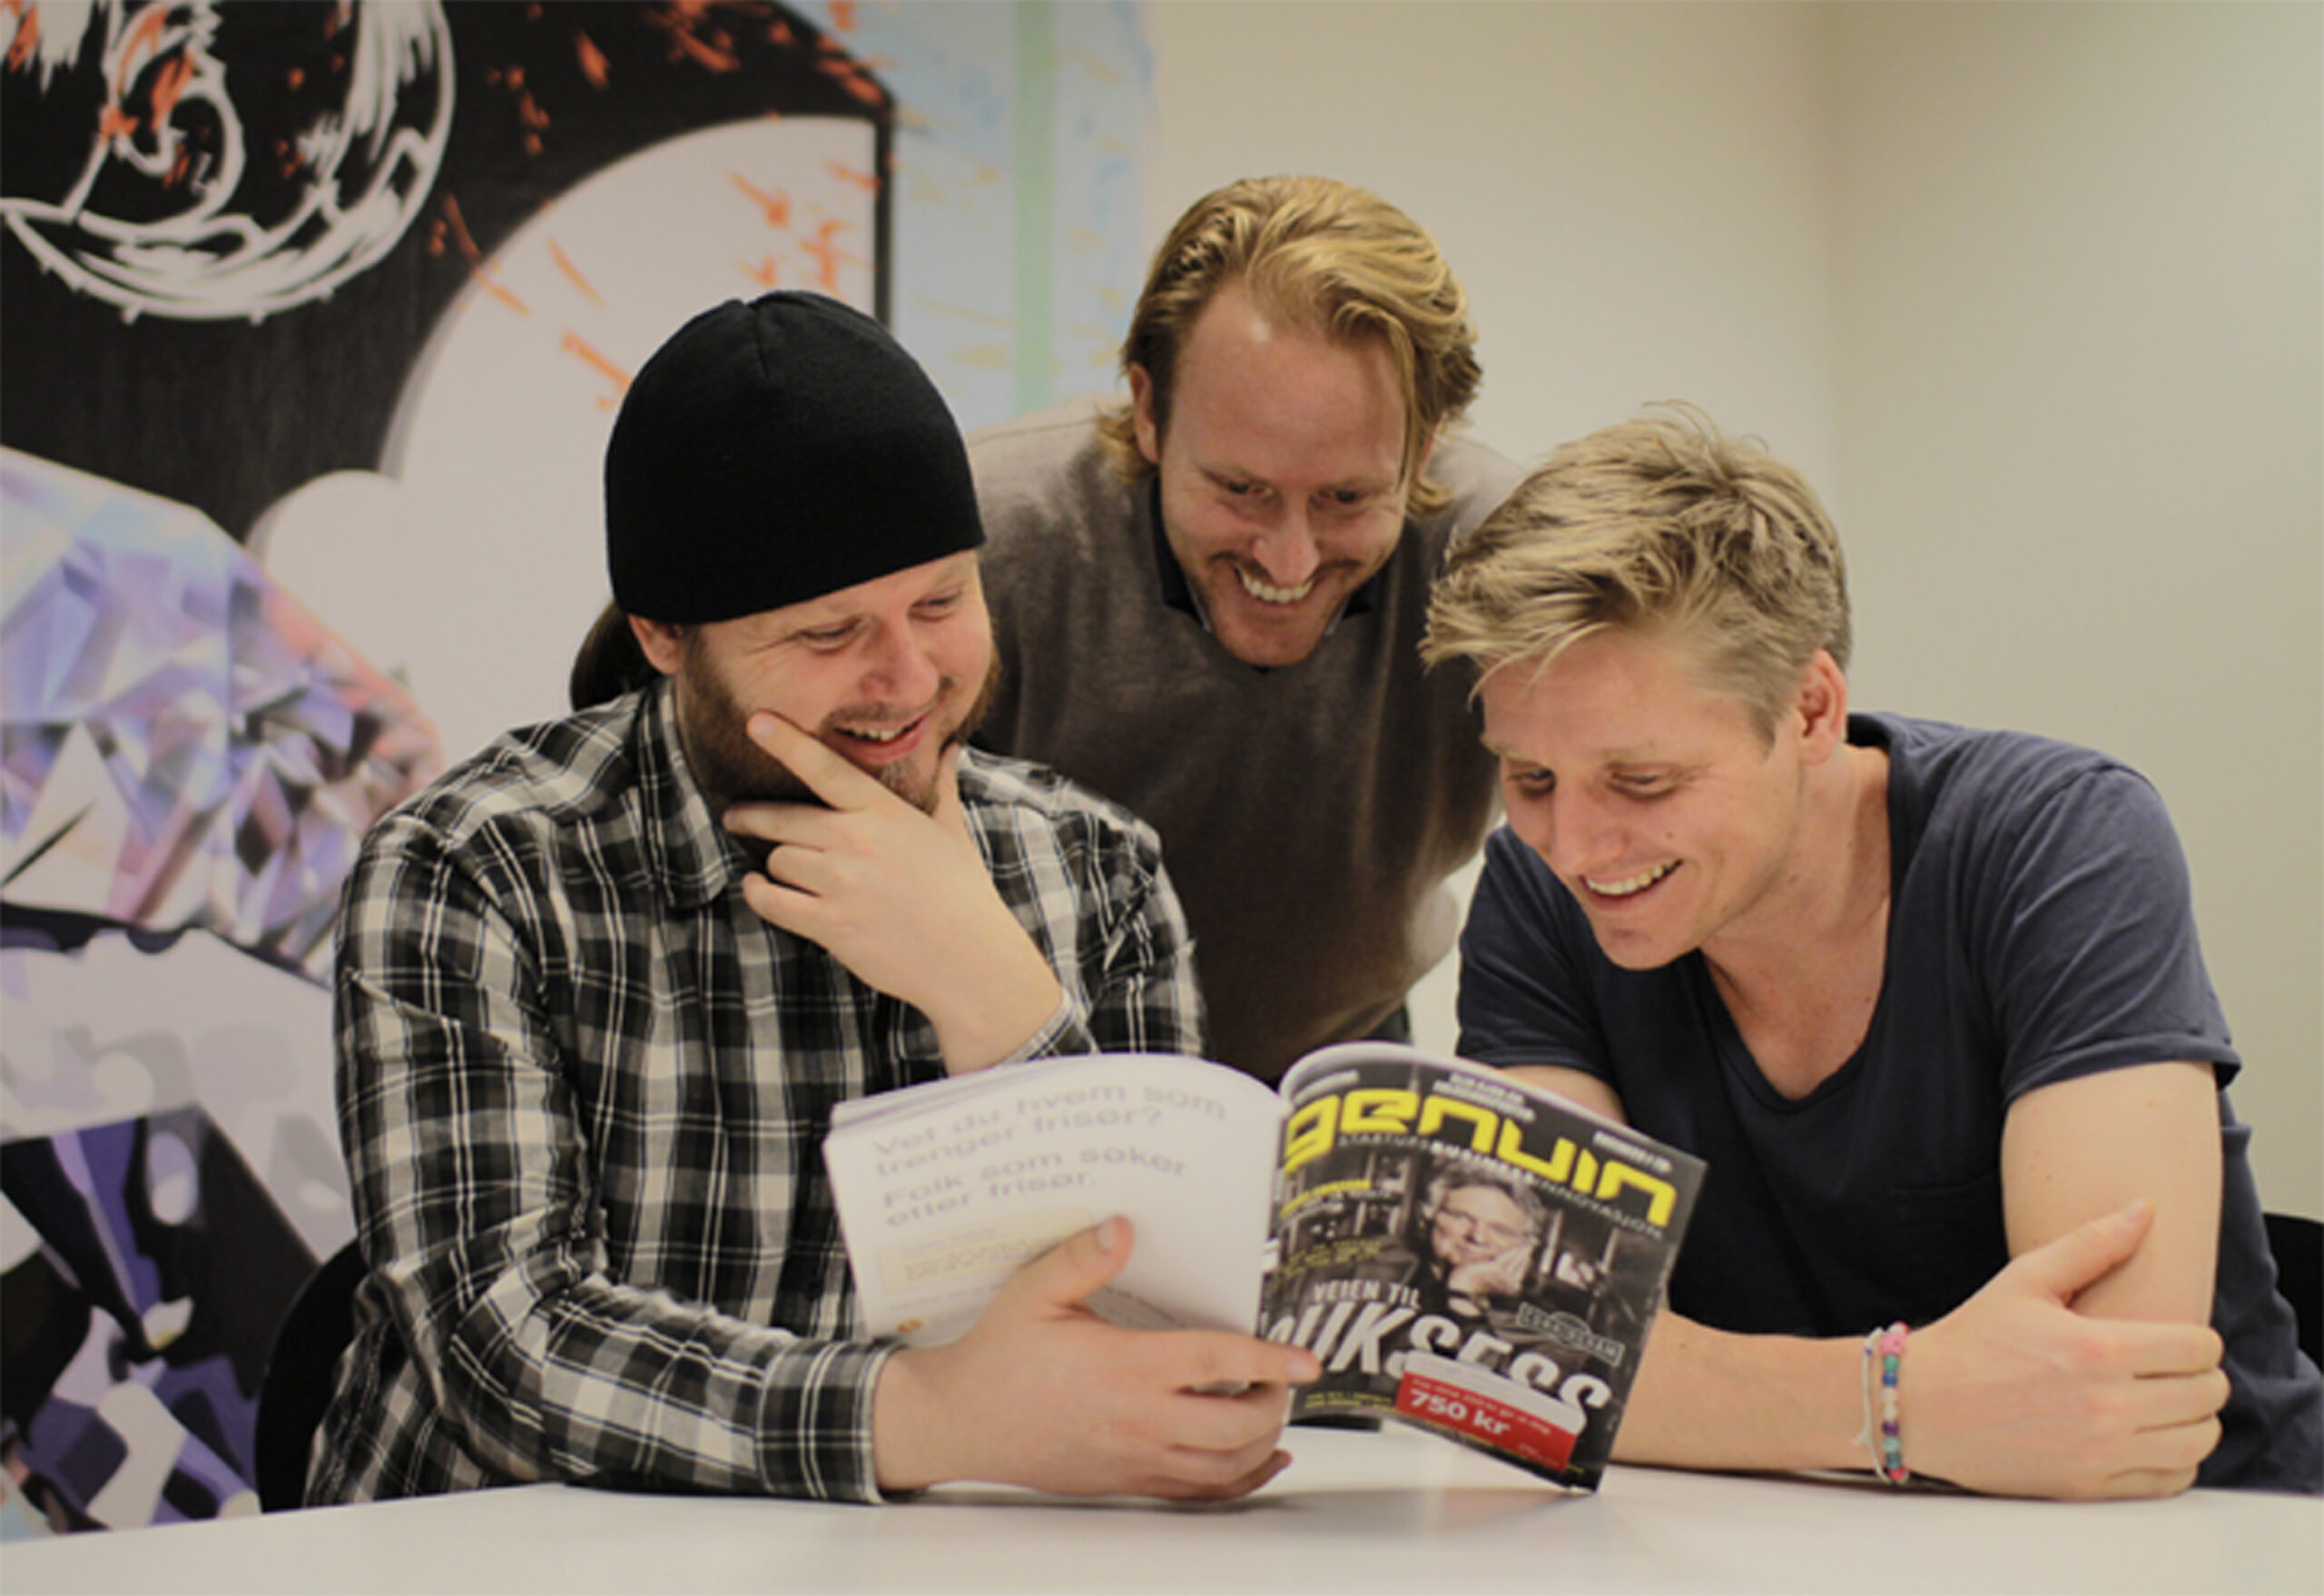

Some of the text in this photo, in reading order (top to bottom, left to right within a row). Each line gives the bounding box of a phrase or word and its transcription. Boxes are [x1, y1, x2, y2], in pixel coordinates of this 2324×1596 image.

[952, 1111, 1000, 1134] du
[1016, 1084, 1127, 1116] hvem
[1143, 1085, 1226, 1121] som
[883, 1174, 965, 1208] Folk
[981, 1151, 1063, 1181] som
[1283, 1089, 1678, 1227] genuin
[1313, 1279, 1421, 1310] VEIEN TIL
[1410, 1388, 1468, 1421] 750
[1472, 1409, 1512, 1435] kr
